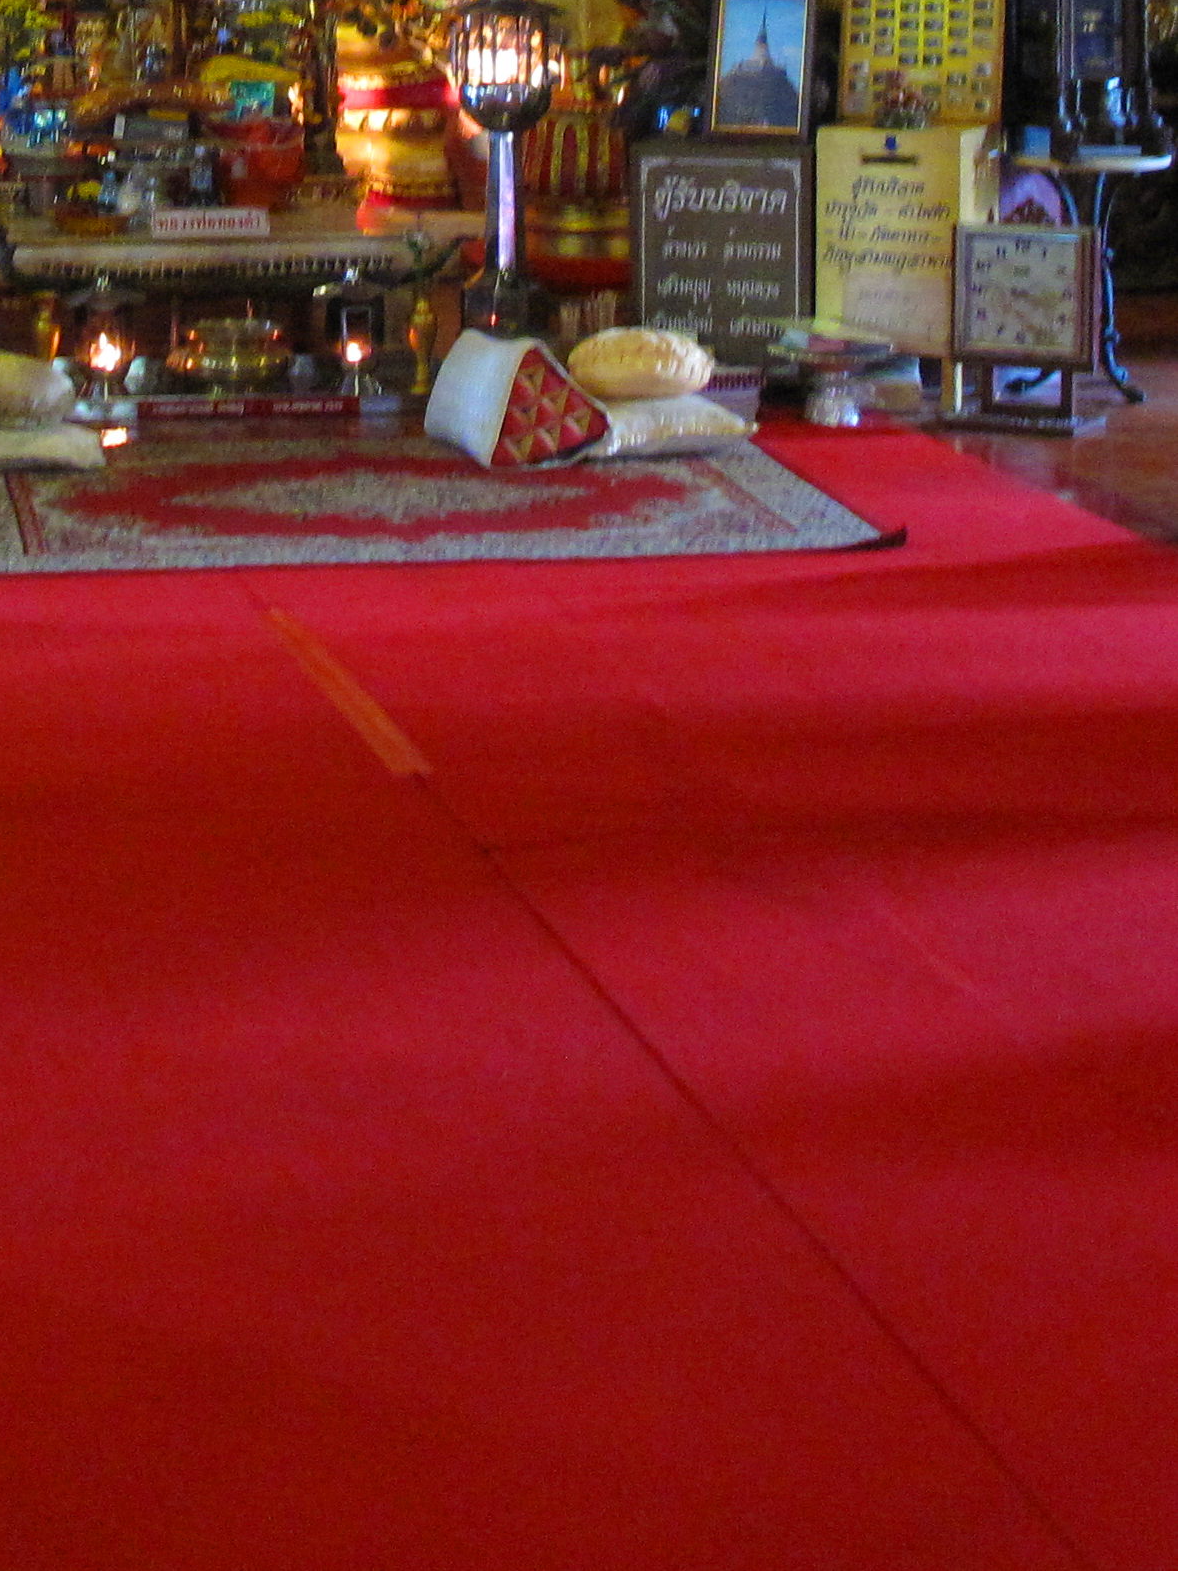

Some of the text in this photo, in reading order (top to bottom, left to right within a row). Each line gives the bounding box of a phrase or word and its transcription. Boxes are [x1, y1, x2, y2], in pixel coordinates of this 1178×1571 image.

[654, 174, 789, 221] ตู้รับบริจาค
